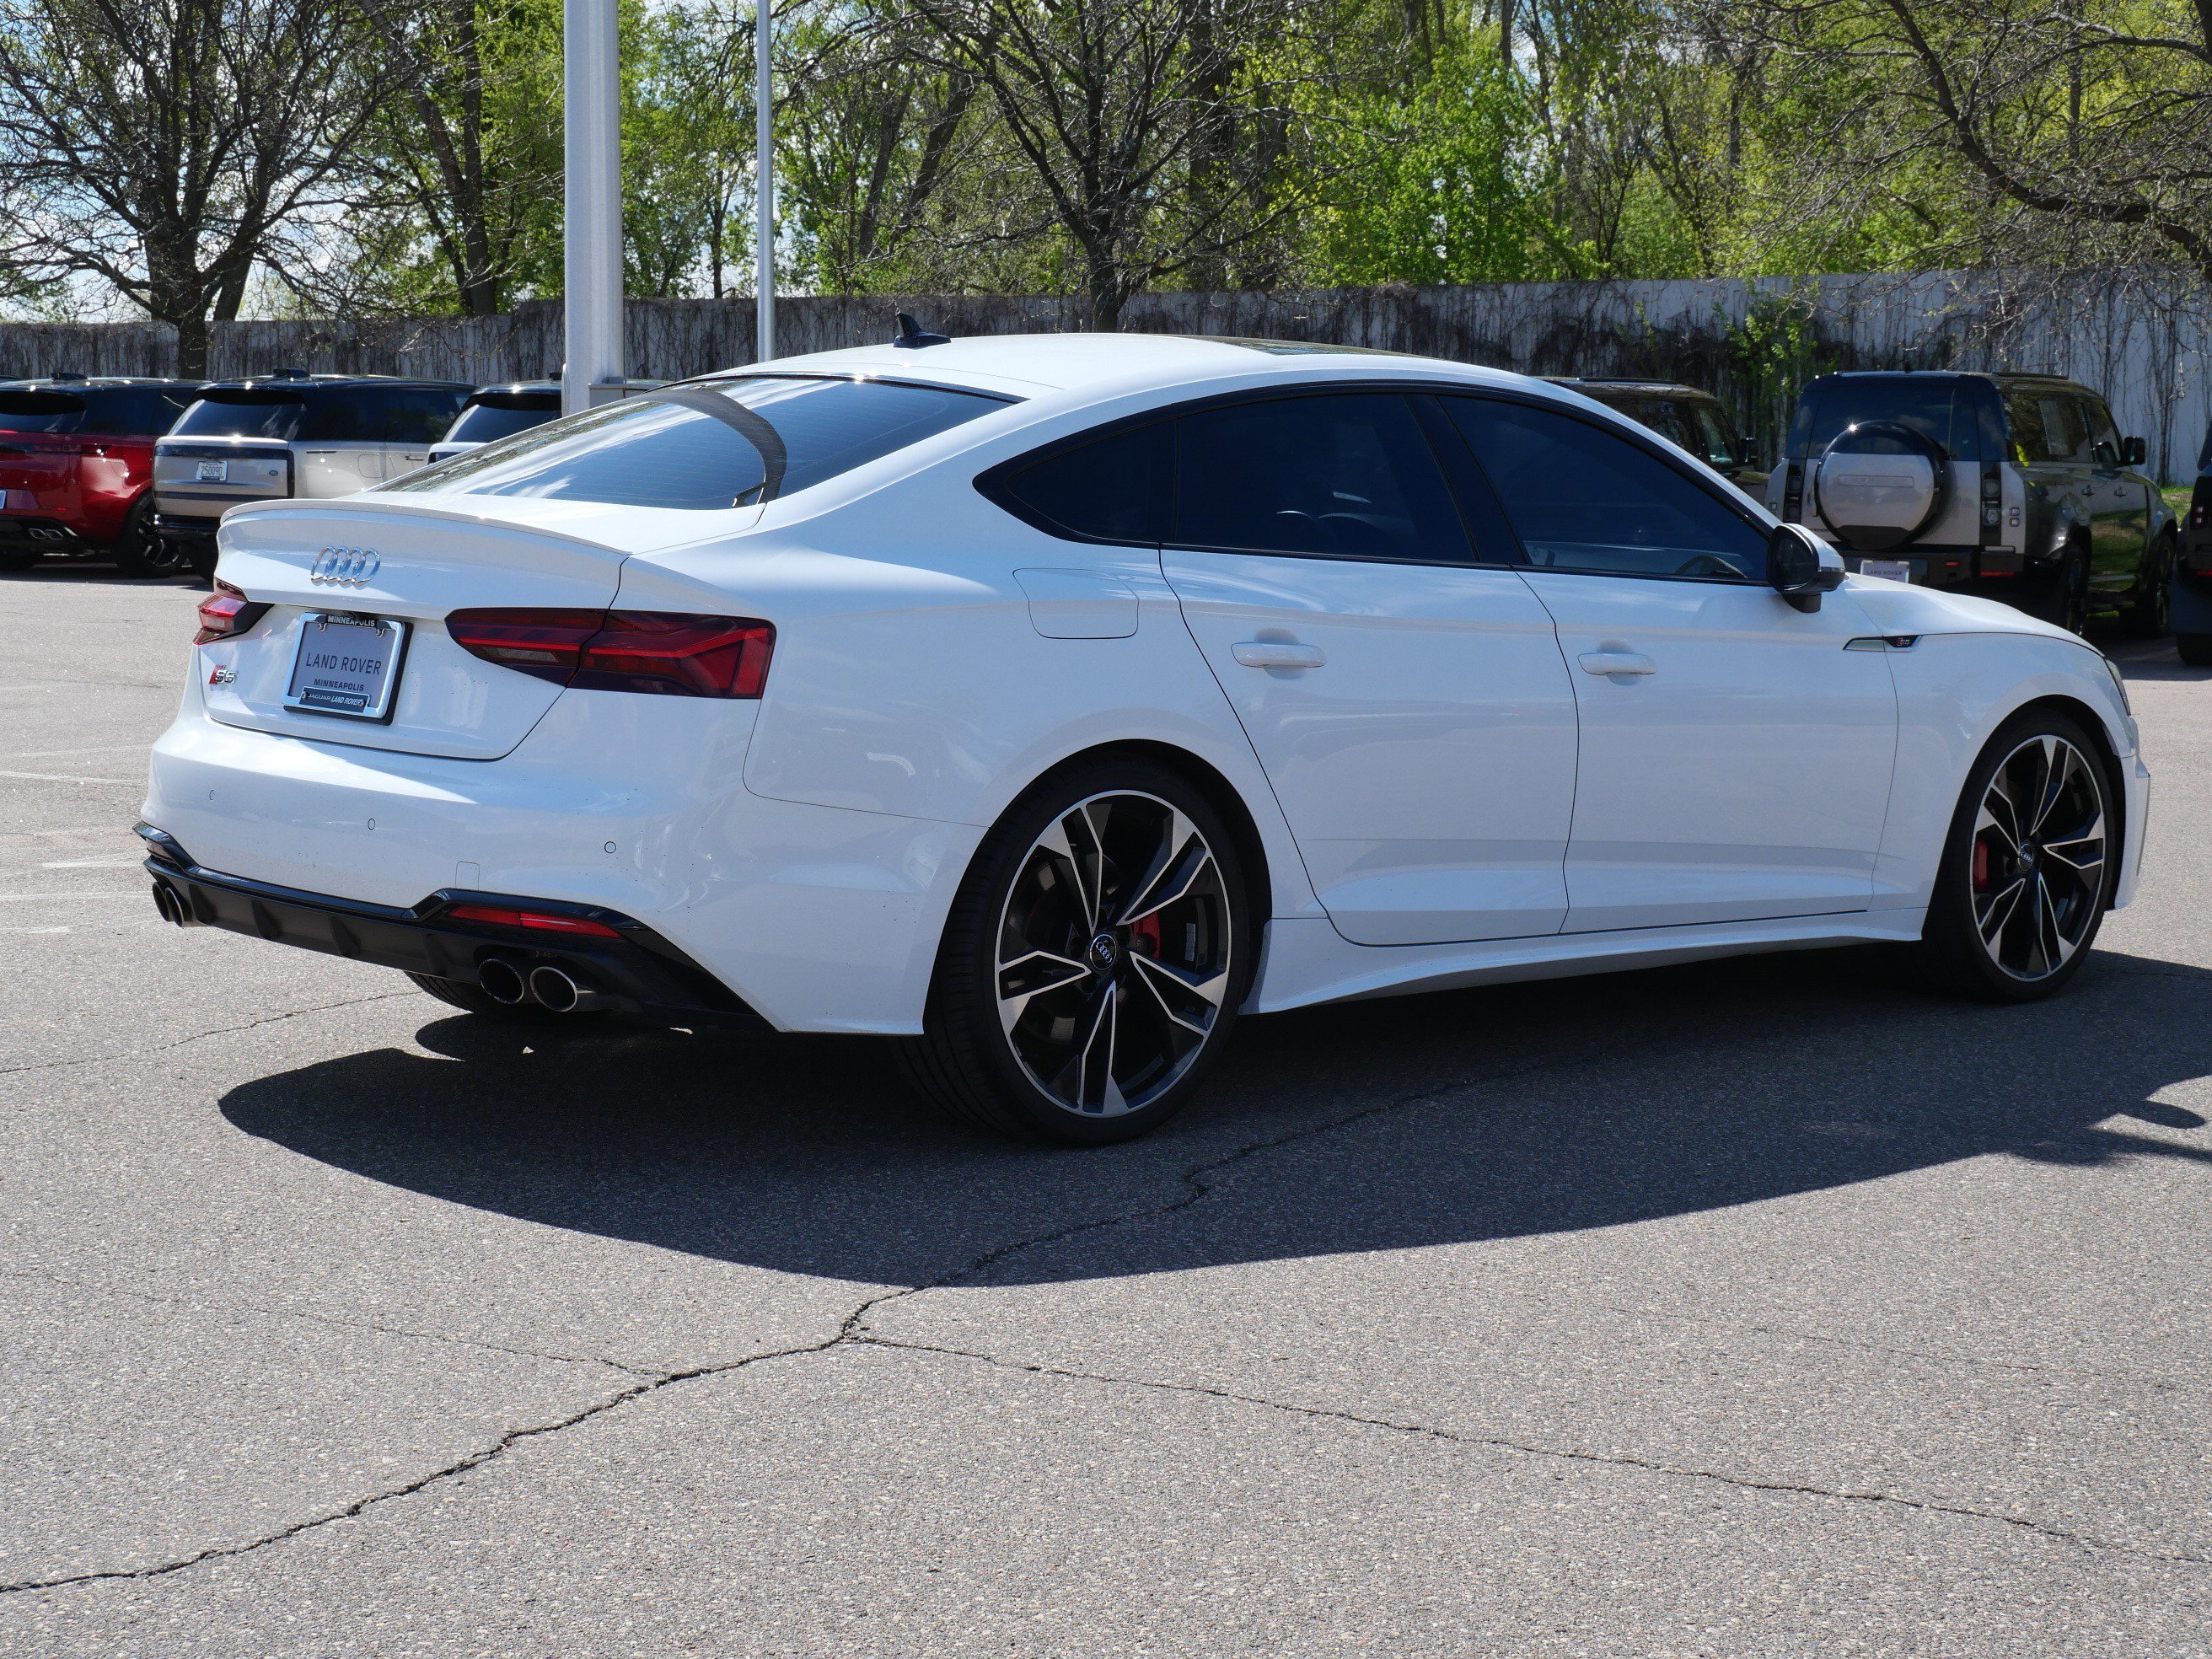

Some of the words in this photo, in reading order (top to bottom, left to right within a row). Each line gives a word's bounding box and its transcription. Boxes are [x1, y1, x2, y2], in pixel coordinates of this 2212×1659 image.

[305, 652, 337, 669] LAND
[341, 656, 382, 674] ROVER
[213, 668, 238, 684] S5
[314, 678, 364, 691] MINNEAPOLIS
[308, 693, 331, 701] JAGUAR
[330, 695, 345, 704] LAND
